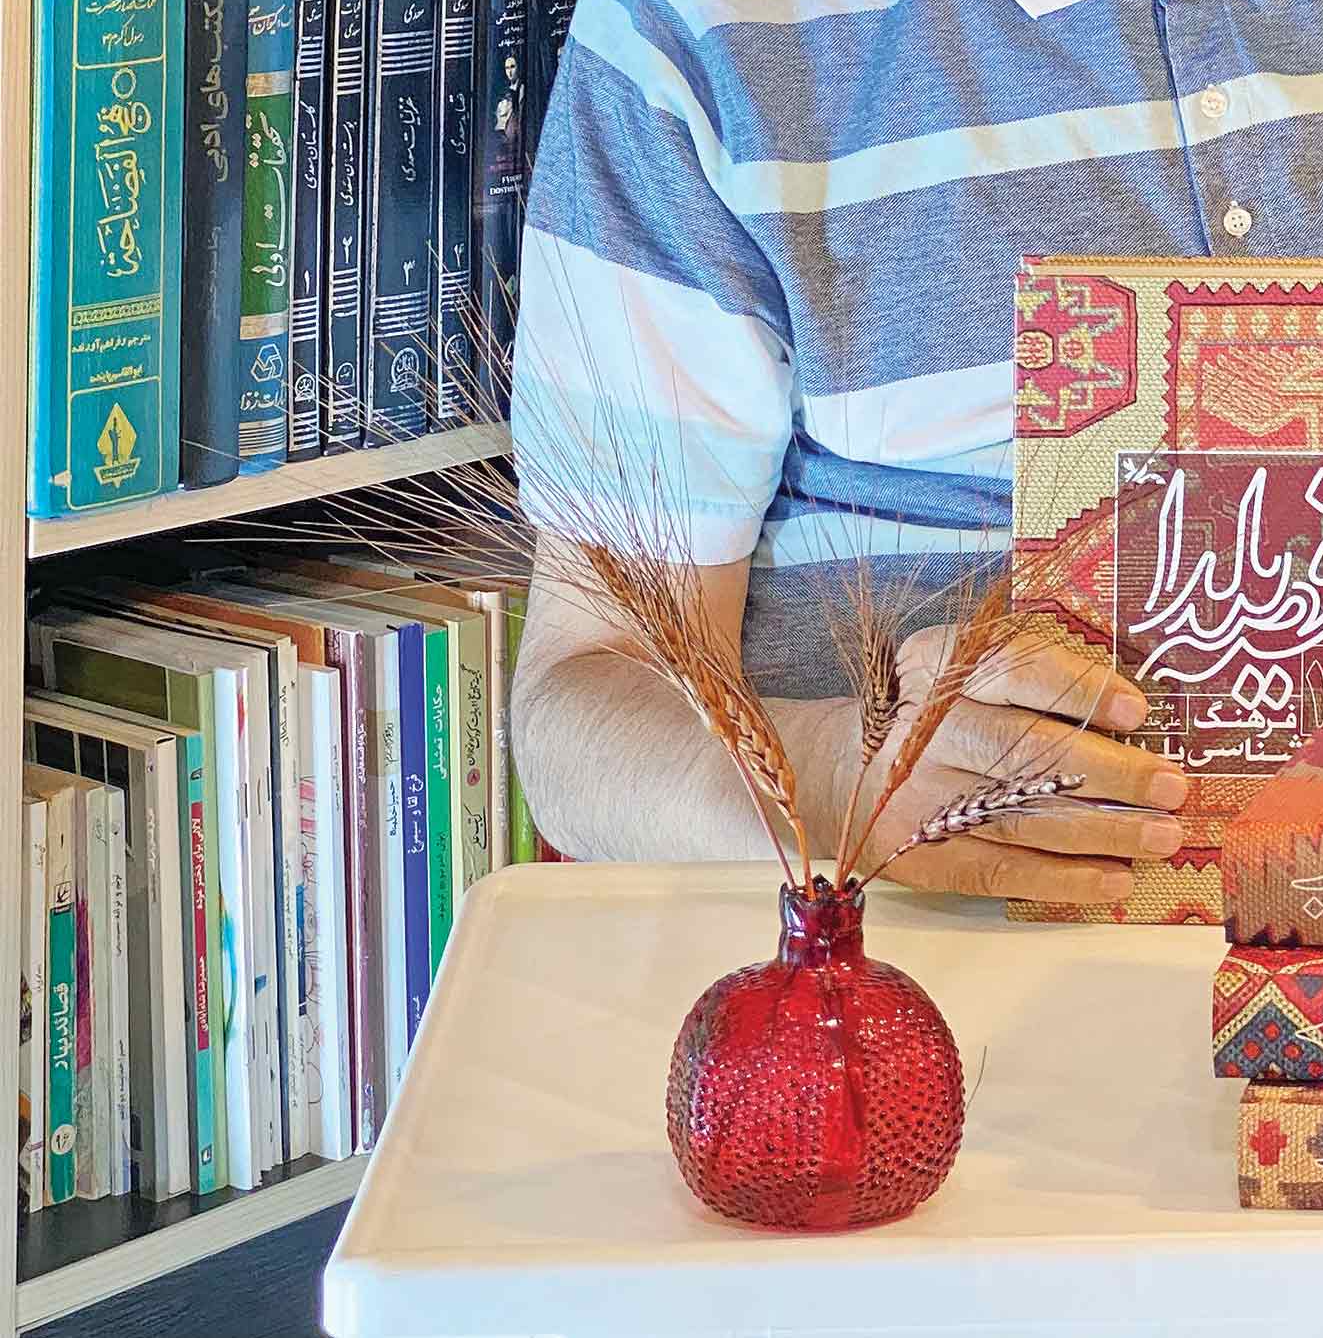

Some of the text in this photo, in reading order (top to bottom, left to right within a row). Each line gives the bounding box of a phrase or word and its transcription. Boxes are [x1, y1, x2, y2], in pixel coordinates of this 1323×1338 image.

[404, 3, 425, 24] سعدی
[342, 235, 352, 263] ۲
[403, 260, 415, 286] ۳
[431, 683, 448, 781] حکایات تمثیلی
[1194, 700, 1298, 739] فرهنگ
[407, 820, 425, 855] سیمرغ
